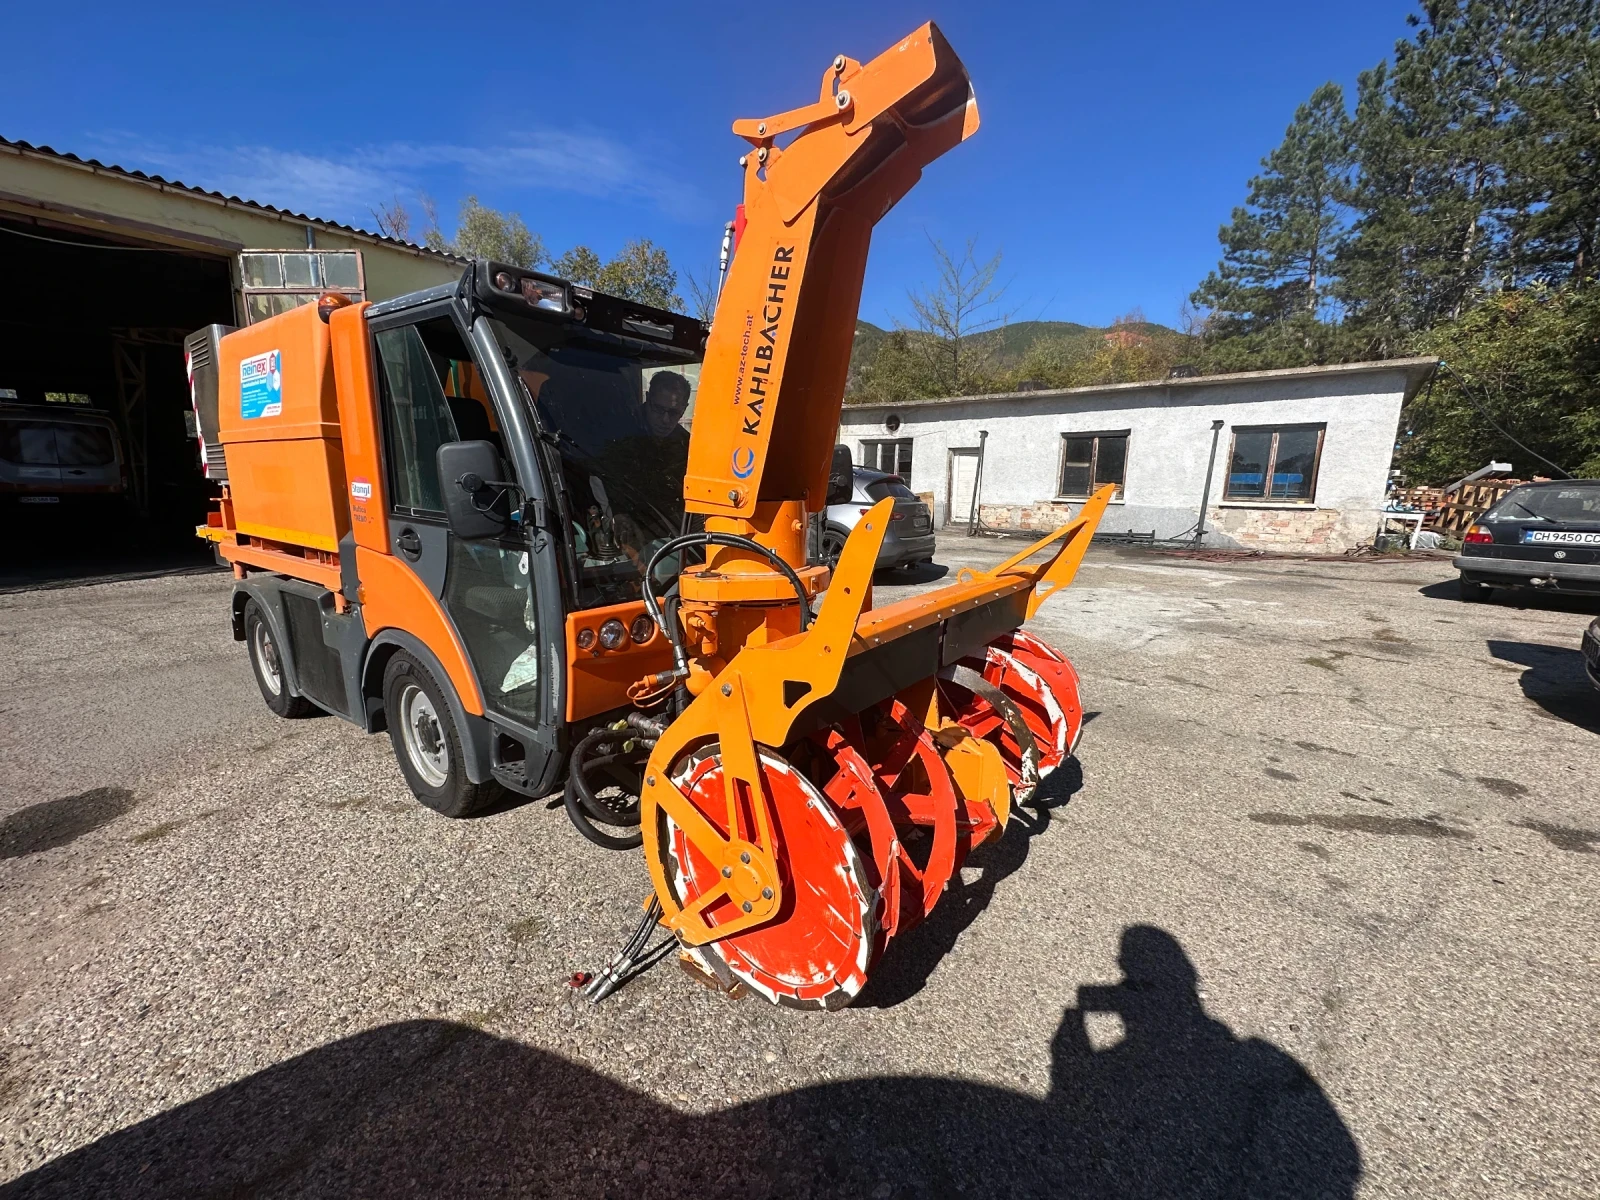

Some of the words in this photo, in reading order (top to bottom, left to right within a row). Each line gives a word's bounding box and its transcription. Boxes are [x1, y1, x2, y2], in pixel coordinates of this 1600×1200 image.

[733, 314, 754, 405] www.az-tech.at
[742, 245, 795, 436] KAHLBACHER
[1534, 532, 1551, 541] CH
[1552, 532, 1582, 542] 9450
